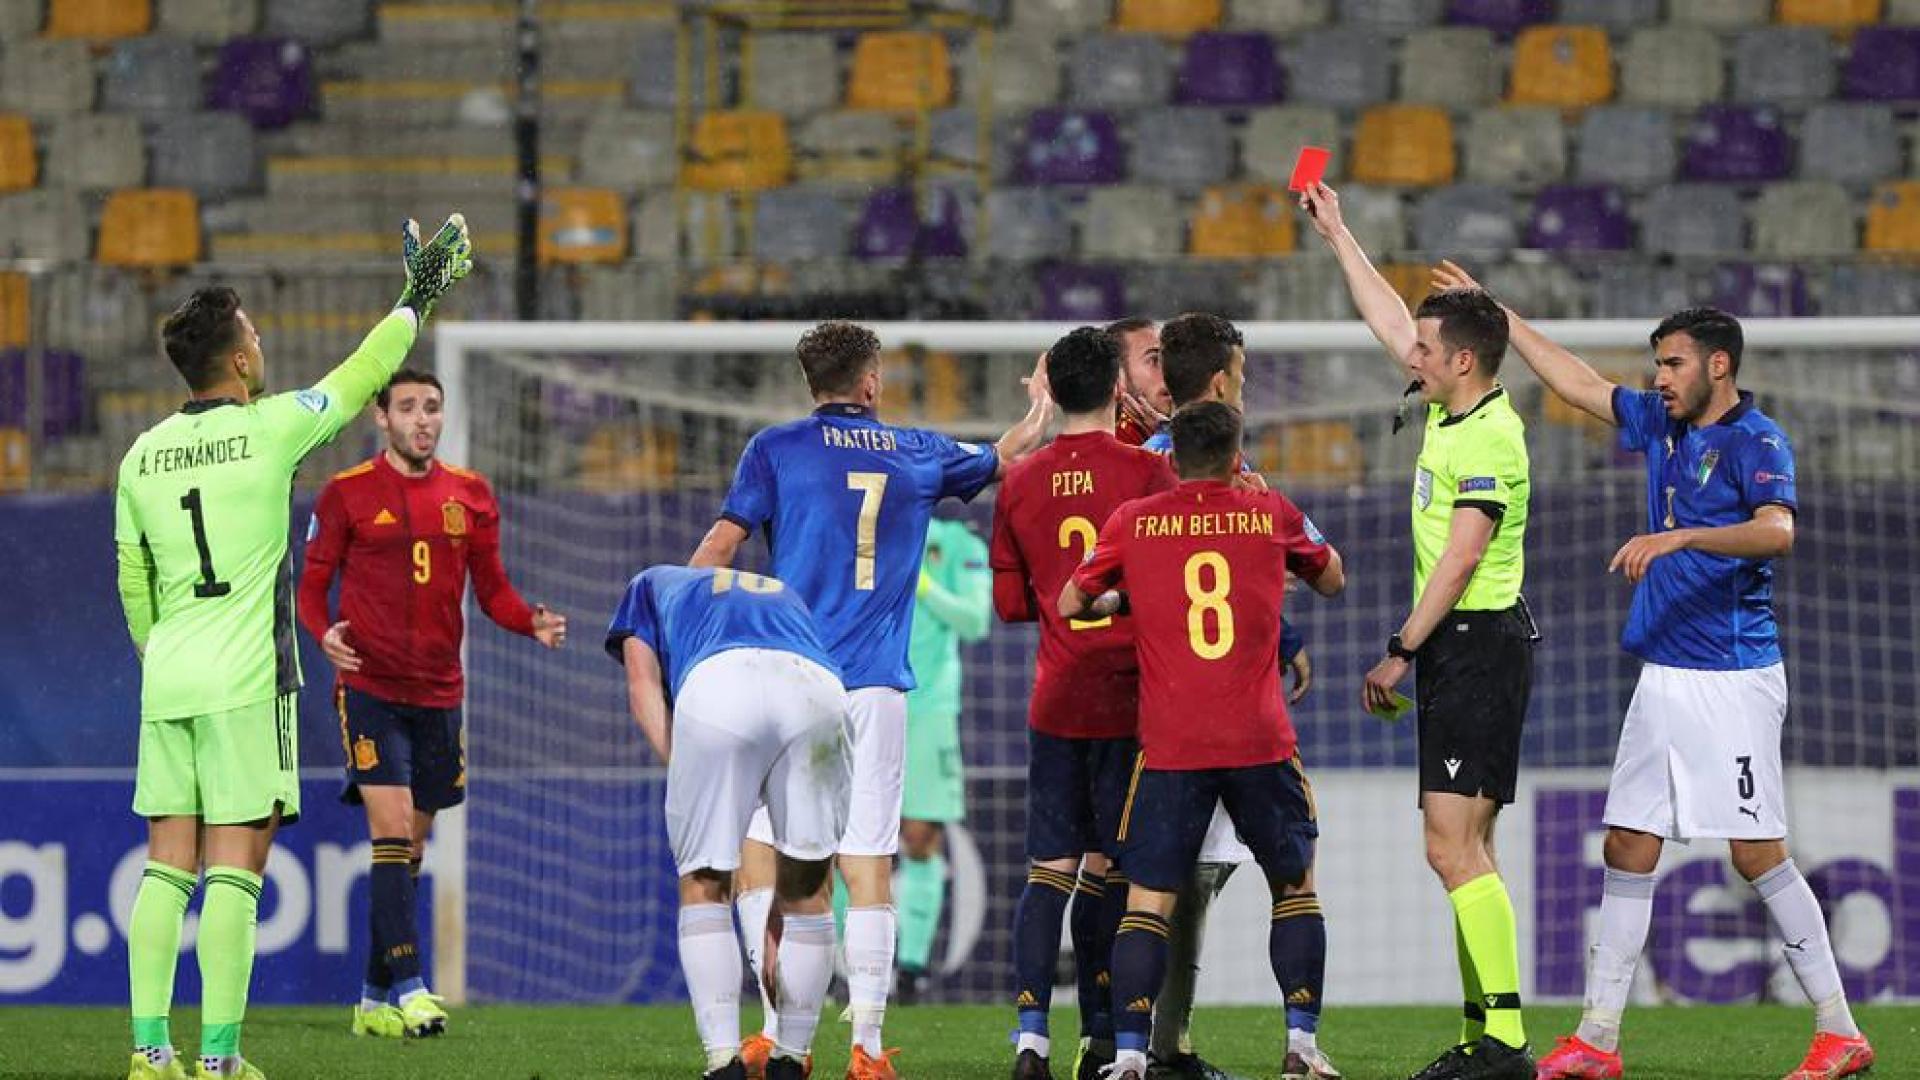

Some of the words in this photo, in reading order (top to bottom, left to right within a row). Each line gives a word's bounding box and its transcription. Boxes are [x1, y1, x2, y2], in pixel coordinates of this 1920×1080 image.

[154, 435, 252, 474] FERNÁNDEZ
[822, 425, 897, 451] FRATTESI
[1052, 470, 1095, 497] PIPA
[180, 487, 232, 598] 1
[847, 472, 889, 591] 7
[1135, 514, 1184, 538] FRAN
[1190, 507, 1273, 537] BELTRÁN
[413, 540, 431, 585] 9
[1184, 551, 1235, 660] 8
[1735, 755, 1755, 800] 3
